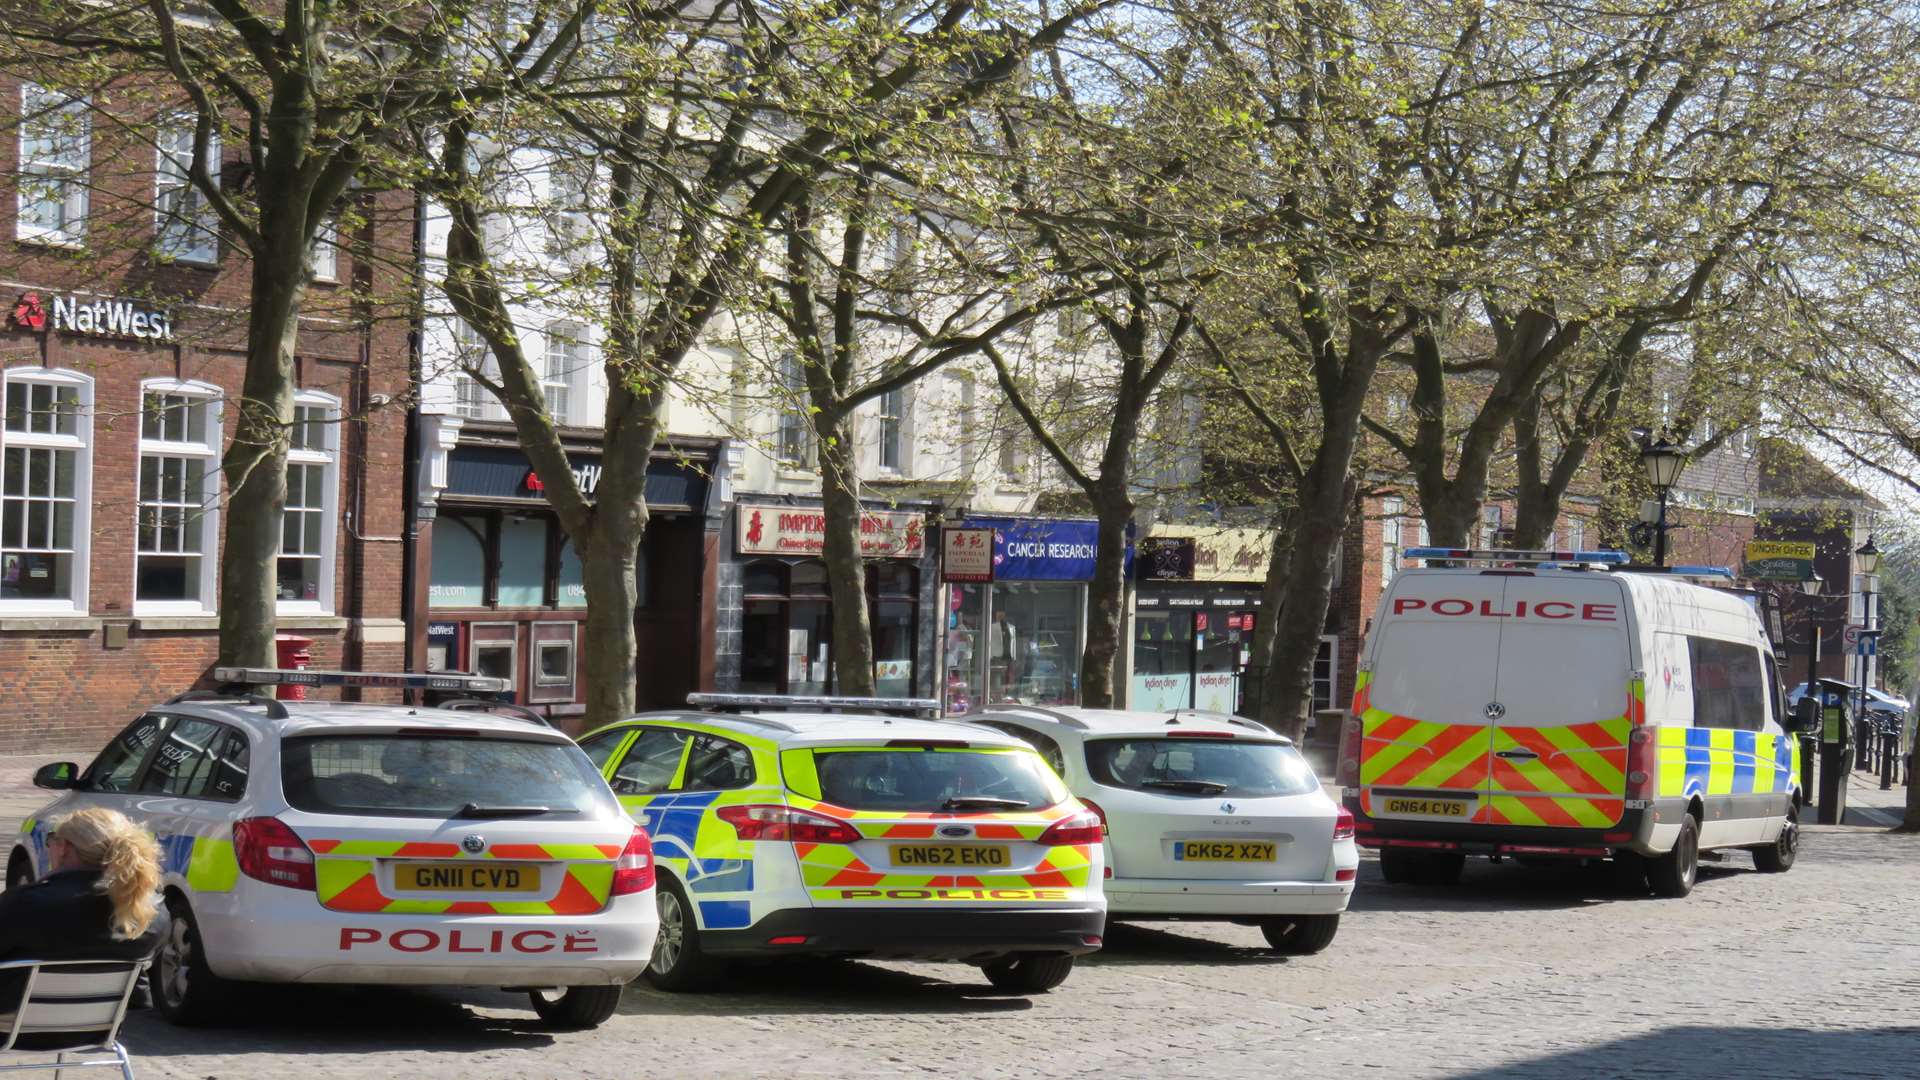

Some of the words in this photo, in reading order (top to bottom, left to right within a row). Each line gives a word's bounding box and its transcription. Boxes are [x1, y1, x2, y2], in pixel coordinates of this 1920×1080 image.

[53, 296, 175, 341] NatWest
[778, 513, 825, 533] IMPER
[1007, 542, 1046, 557] CANCER
[1048, 543, 1094, 559] RESEARCH
[1393, 598, 1617, 621] POLICE
[1390, 800, 1428, 813] GN64
[1431, 802, 1460, 815] CVS
[899, 847, 954, 864] GN62
[1187, 843, 1234, 858] GK62
[1240, 844, 1273, 859] XZY
[471, 869, 520, 888] CVD
[840, 889, 1068, 900] POLICE
[339, 927, 598, 953] POLICE
